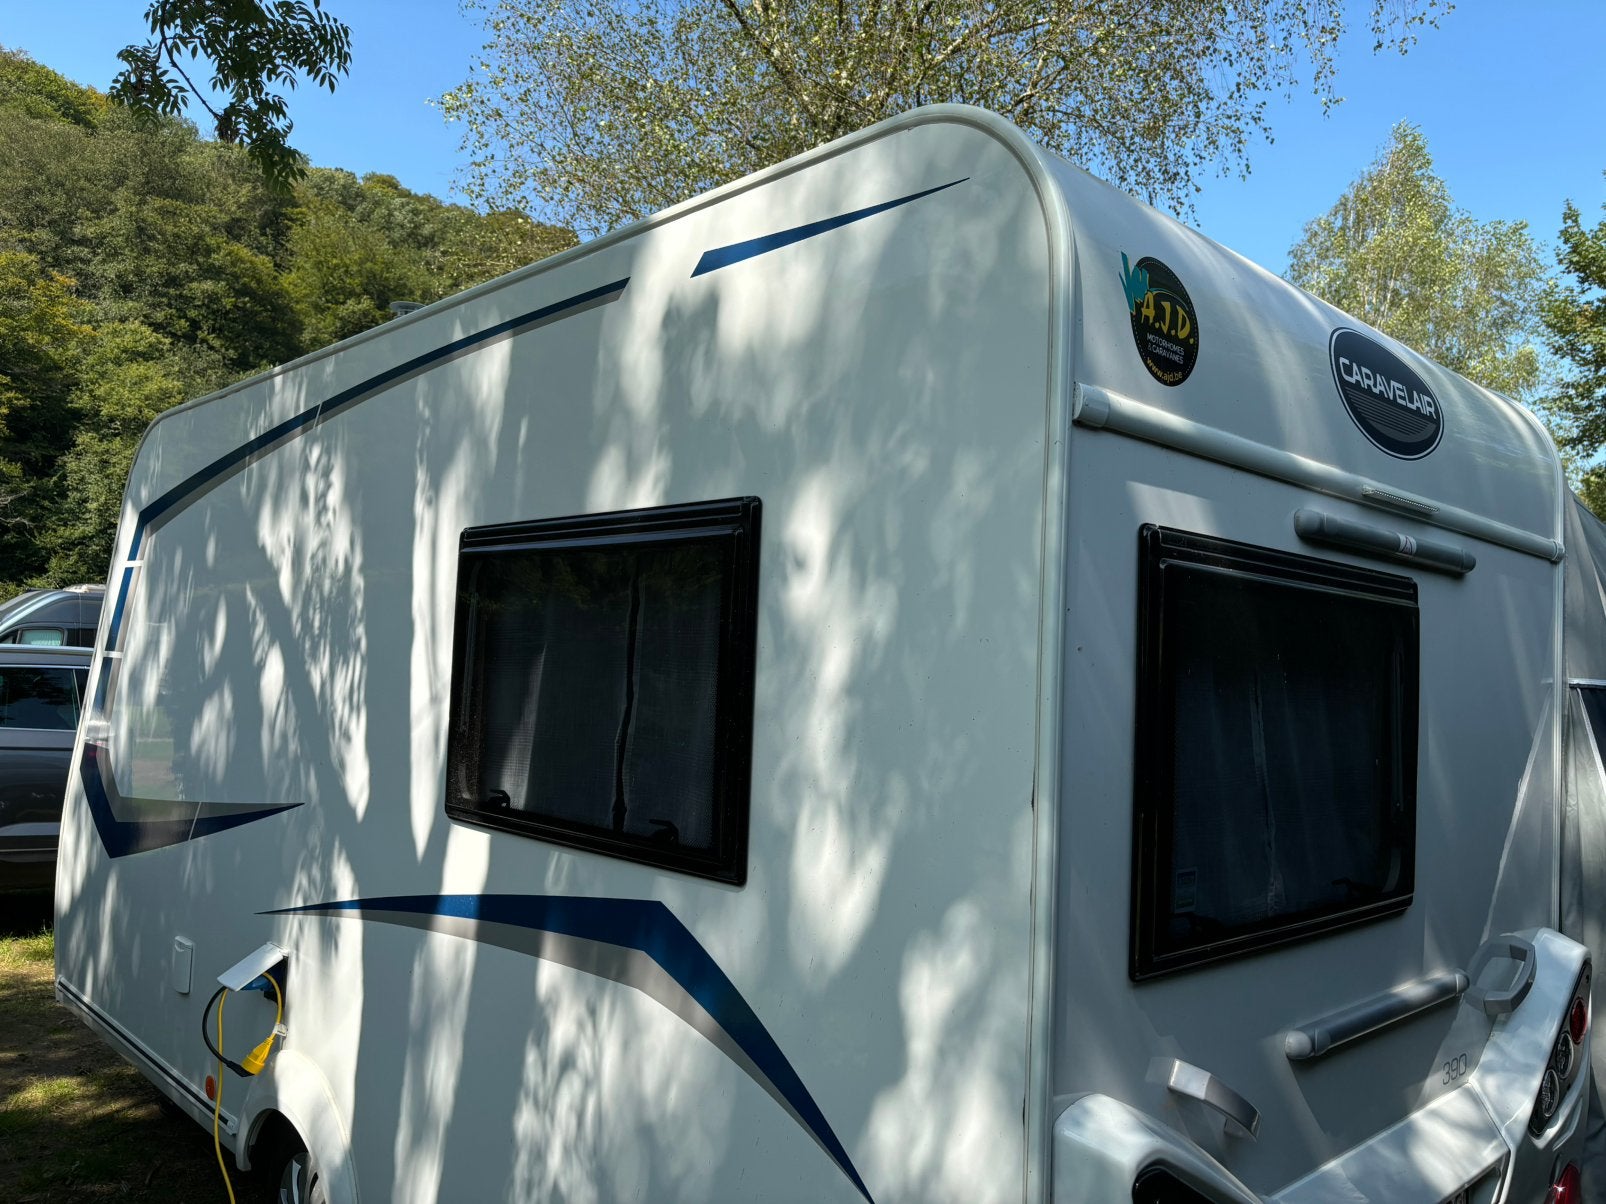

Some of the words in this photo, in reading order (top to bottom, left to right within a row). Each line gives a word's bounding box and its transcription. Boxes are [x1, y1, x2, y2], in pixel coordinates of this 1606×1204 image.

[1141, 291, 1194, 345] A.J.D.
[1147, 332, 1185, 356] MOTORHOMES
[1152, 347, 1184, 365] CARAVANES
[1147, 357, 1183, 383] www.ajd.be
[1340, 356, 1436, 419] CARAVELAIR
[1442, 1053, 1467, 1085] 390
